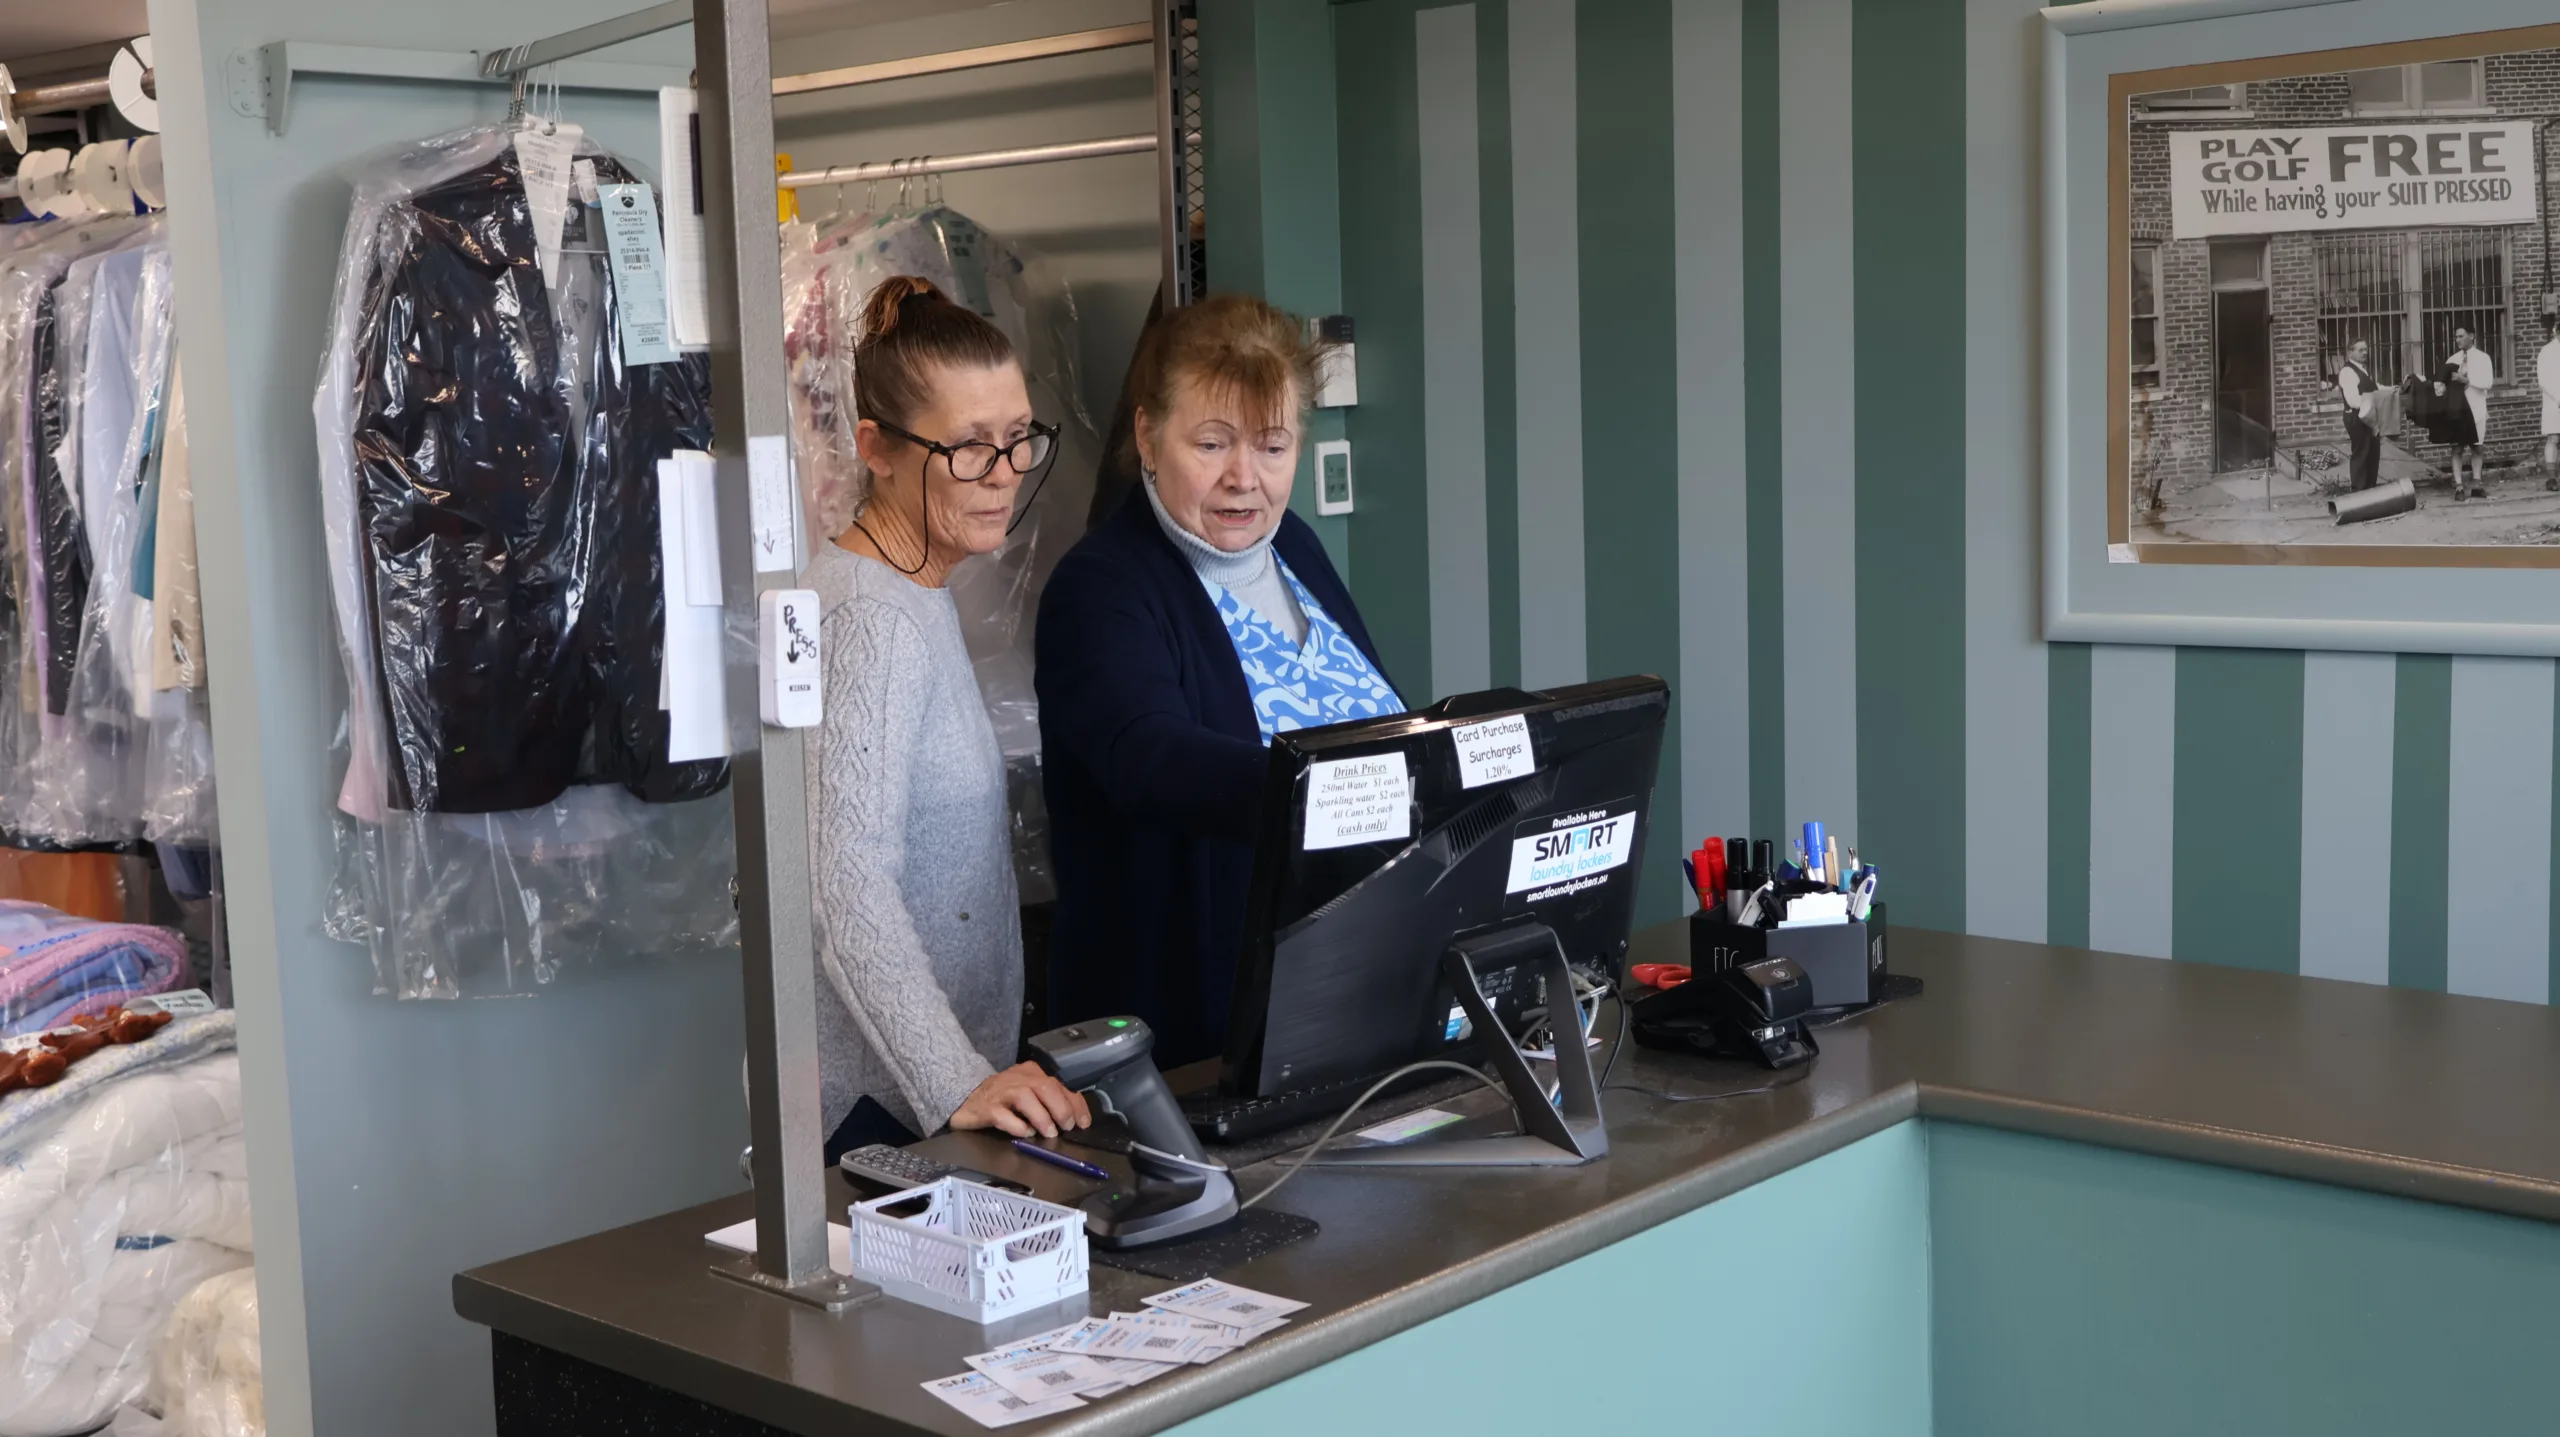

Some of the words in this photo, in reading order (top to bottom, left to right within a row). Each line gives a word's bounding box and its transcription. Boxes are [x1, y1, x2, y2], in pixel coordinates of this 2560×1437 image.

[2200, 137, 2302, 159] PLAY
[2328, 131, 2506, 182] FREE
[2202, 158, 2309, 184] GOLF
[2201, 188, 2258, 214] While
[2265, 184, 2328, 219] having
[2335, 191, 2381, 218] your
[2387, 181, 2428, 206] SUIT
[2434, 178, 2512, 204] PRESSED
[783, 604, 817, 659] PRESS
[1456, 728, 1480, 743] Card
[1482, 722, 1525, 738] Purchase
[1469, 744, 1522, 763] Surcharges
[1333, 764, 1359, 779] Drink
[1361, 762, 1388, 775] Prices
[1485, 764, 1512, 780] 1.20%
[1321, 783, 1345, 794] 250ml
[1347, 781, 1368, 791] Water
[1383, 775, 1400, 786] each
[1315, 796, 1354, 810] Sparkling
[1355, 794, 1376, 804] water
[1379, 790, 1389, 800] $2
[1390, 788, 1406, 799] each
[1330, 809, 1344, 820] All
[1345, 807, 1364, 818] Cans
[1366, 805, 1376, 816] $2
[1376, 803, 1394, 814] each
[1552, 812, 1588, 829] Available
[1588, 809, 1608, 821] Here
[1337, 821, 1363, 836] (cash
[1364, 819, 1388, 832] only)
[1534, 820, 1619, 862] SMART
[1530, 859, 1575, 883] laundry
[1577, 851, 1613, 871] lockers
[1526, 874, 1608, 903] smartlaundrylockers.au
